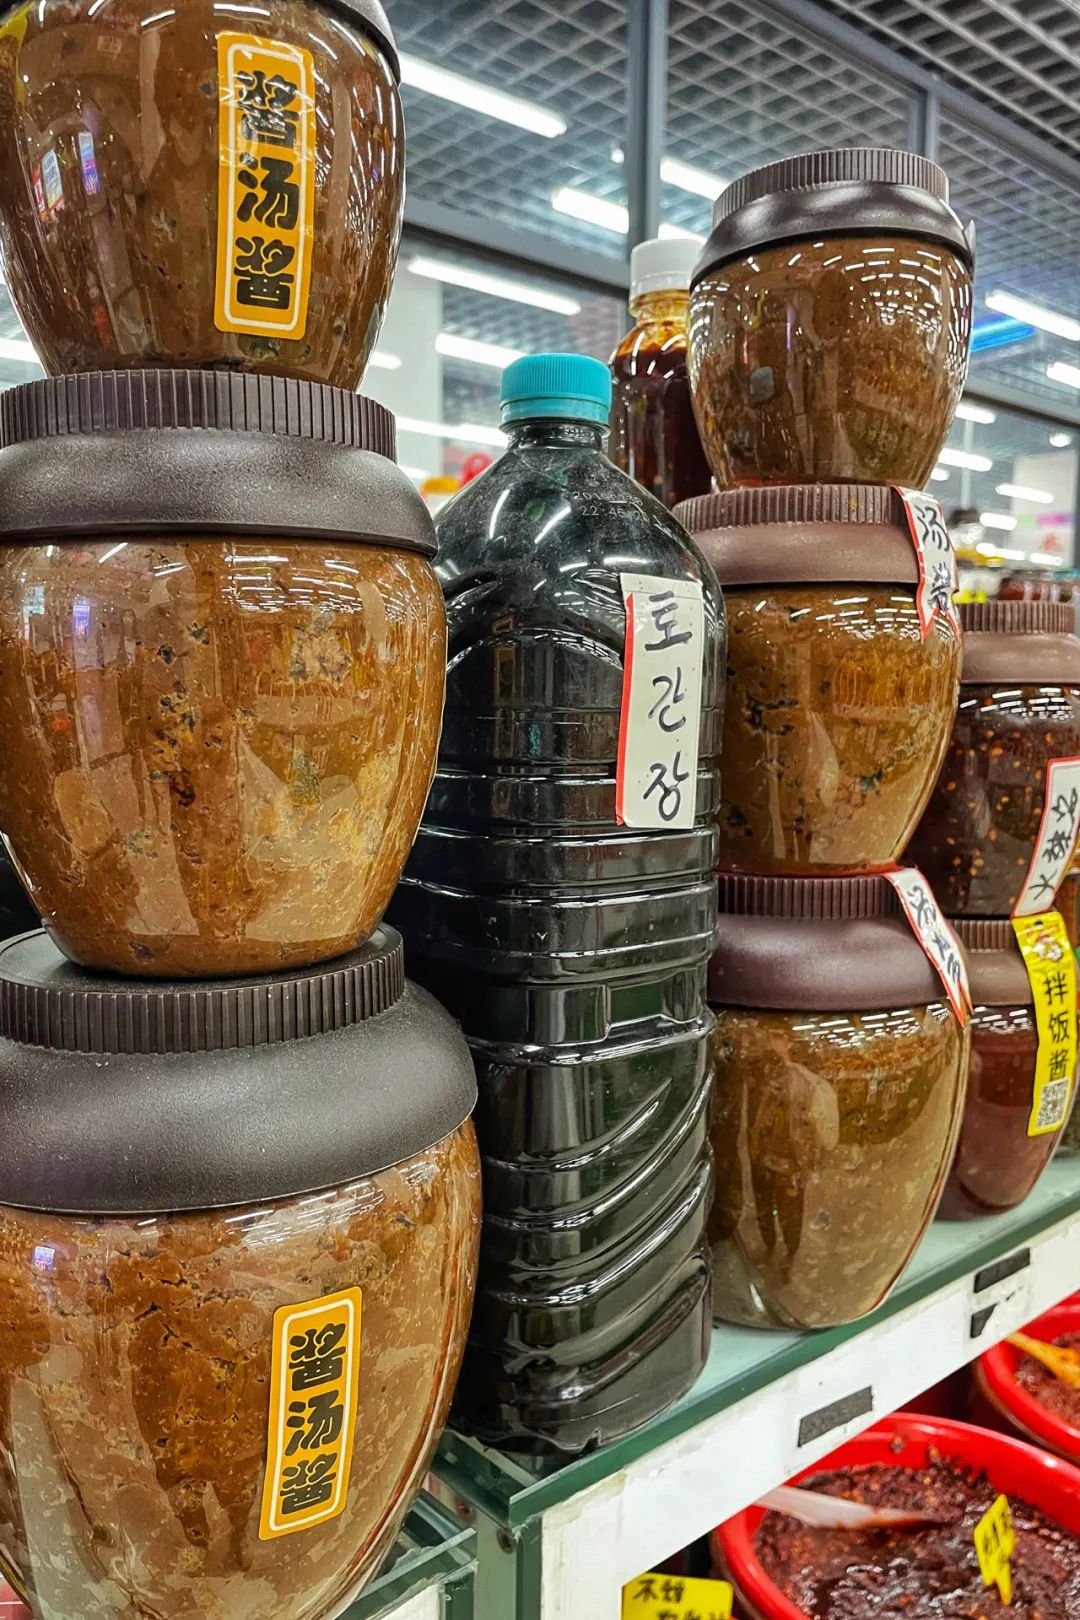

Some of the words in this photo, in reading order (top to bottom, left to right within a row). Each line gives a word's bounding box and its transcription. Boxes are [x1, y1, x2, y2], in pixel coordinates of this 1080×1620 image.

[234, 70, 299, 310] 酱汤酱
[644, 590, 693, 822] 토간장
[1043, 972, 1070, 1081] 拌饭酱
[279, 1322, 347, 1515] 酱汤酱
